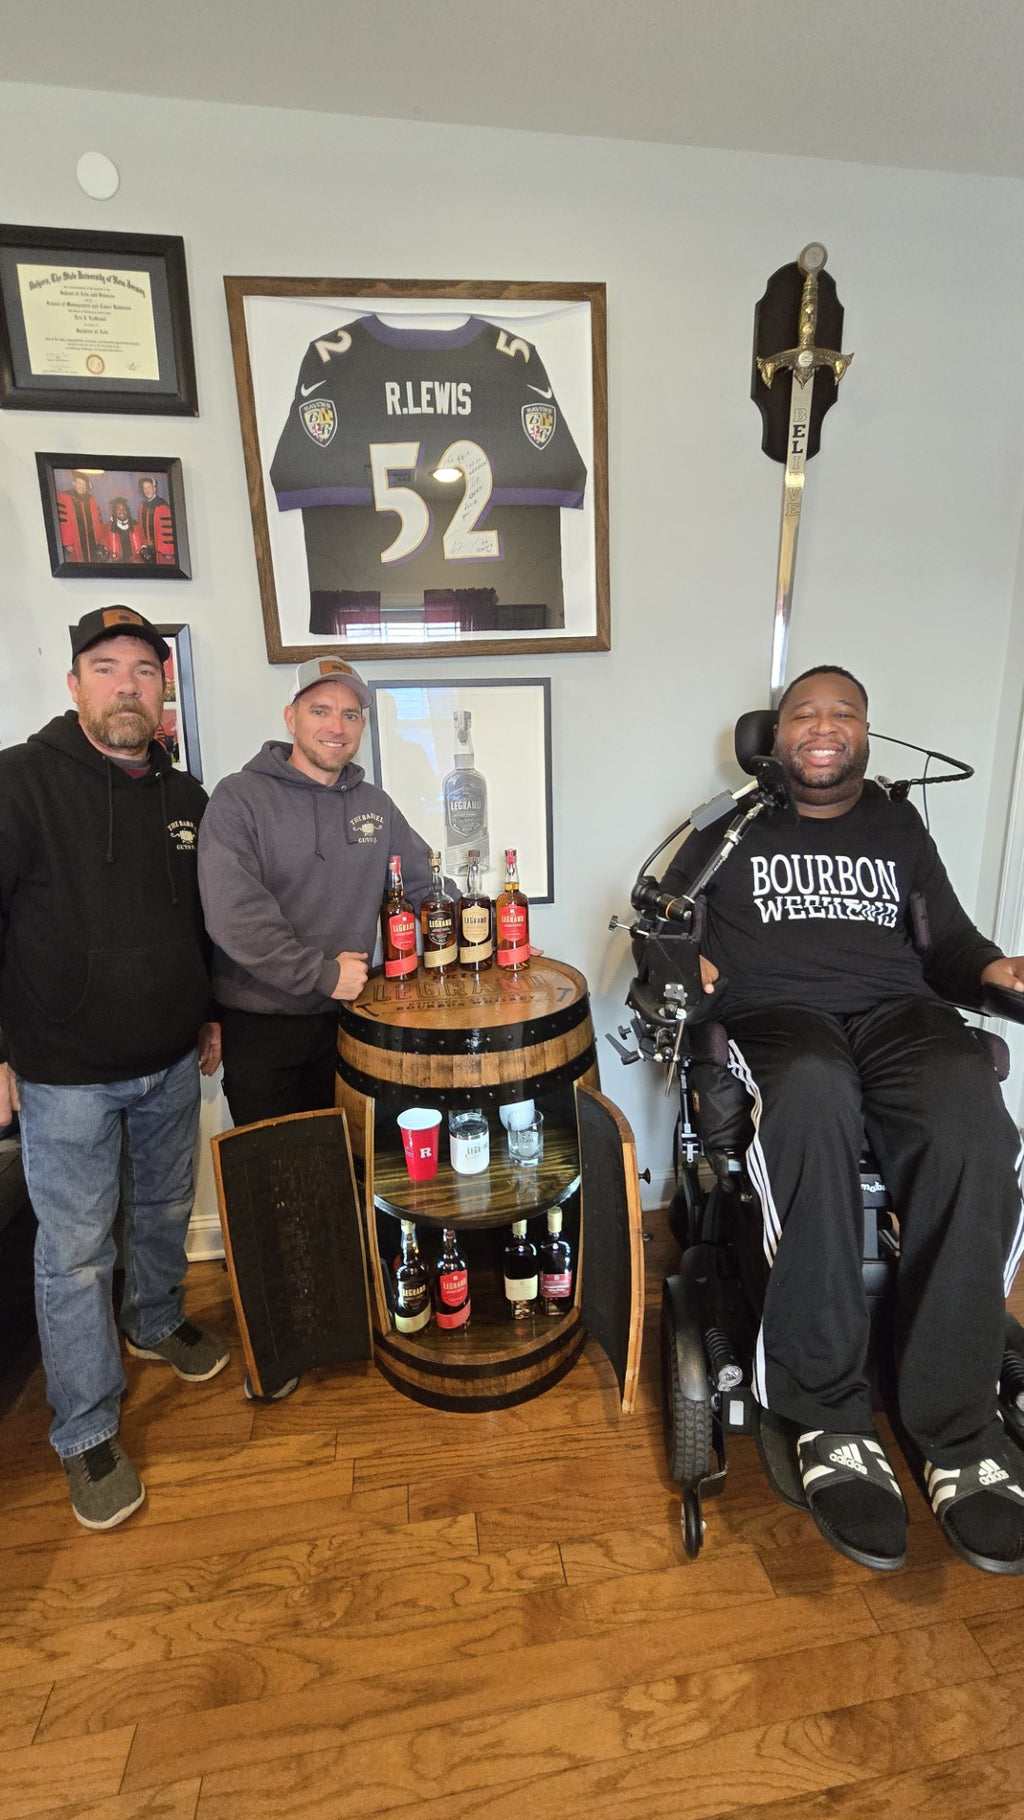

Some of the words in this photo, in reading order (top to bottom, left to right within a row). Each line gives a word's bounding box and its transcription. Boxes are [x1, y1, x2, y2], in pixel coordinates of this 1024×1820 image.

[495, 329, 531, 364] 5
[384, 380, 472, 416] R.LEWIS
[368, 439, 501, 564] 52
[750, 854, 900, 902] BOURBON
[754, 895, 899, 929] WEEKEND
[420, 1147, 432, 1159] R
[829, 1452, 868, 1475] adidas
[978, 1469, 1010, 1486] adidas
